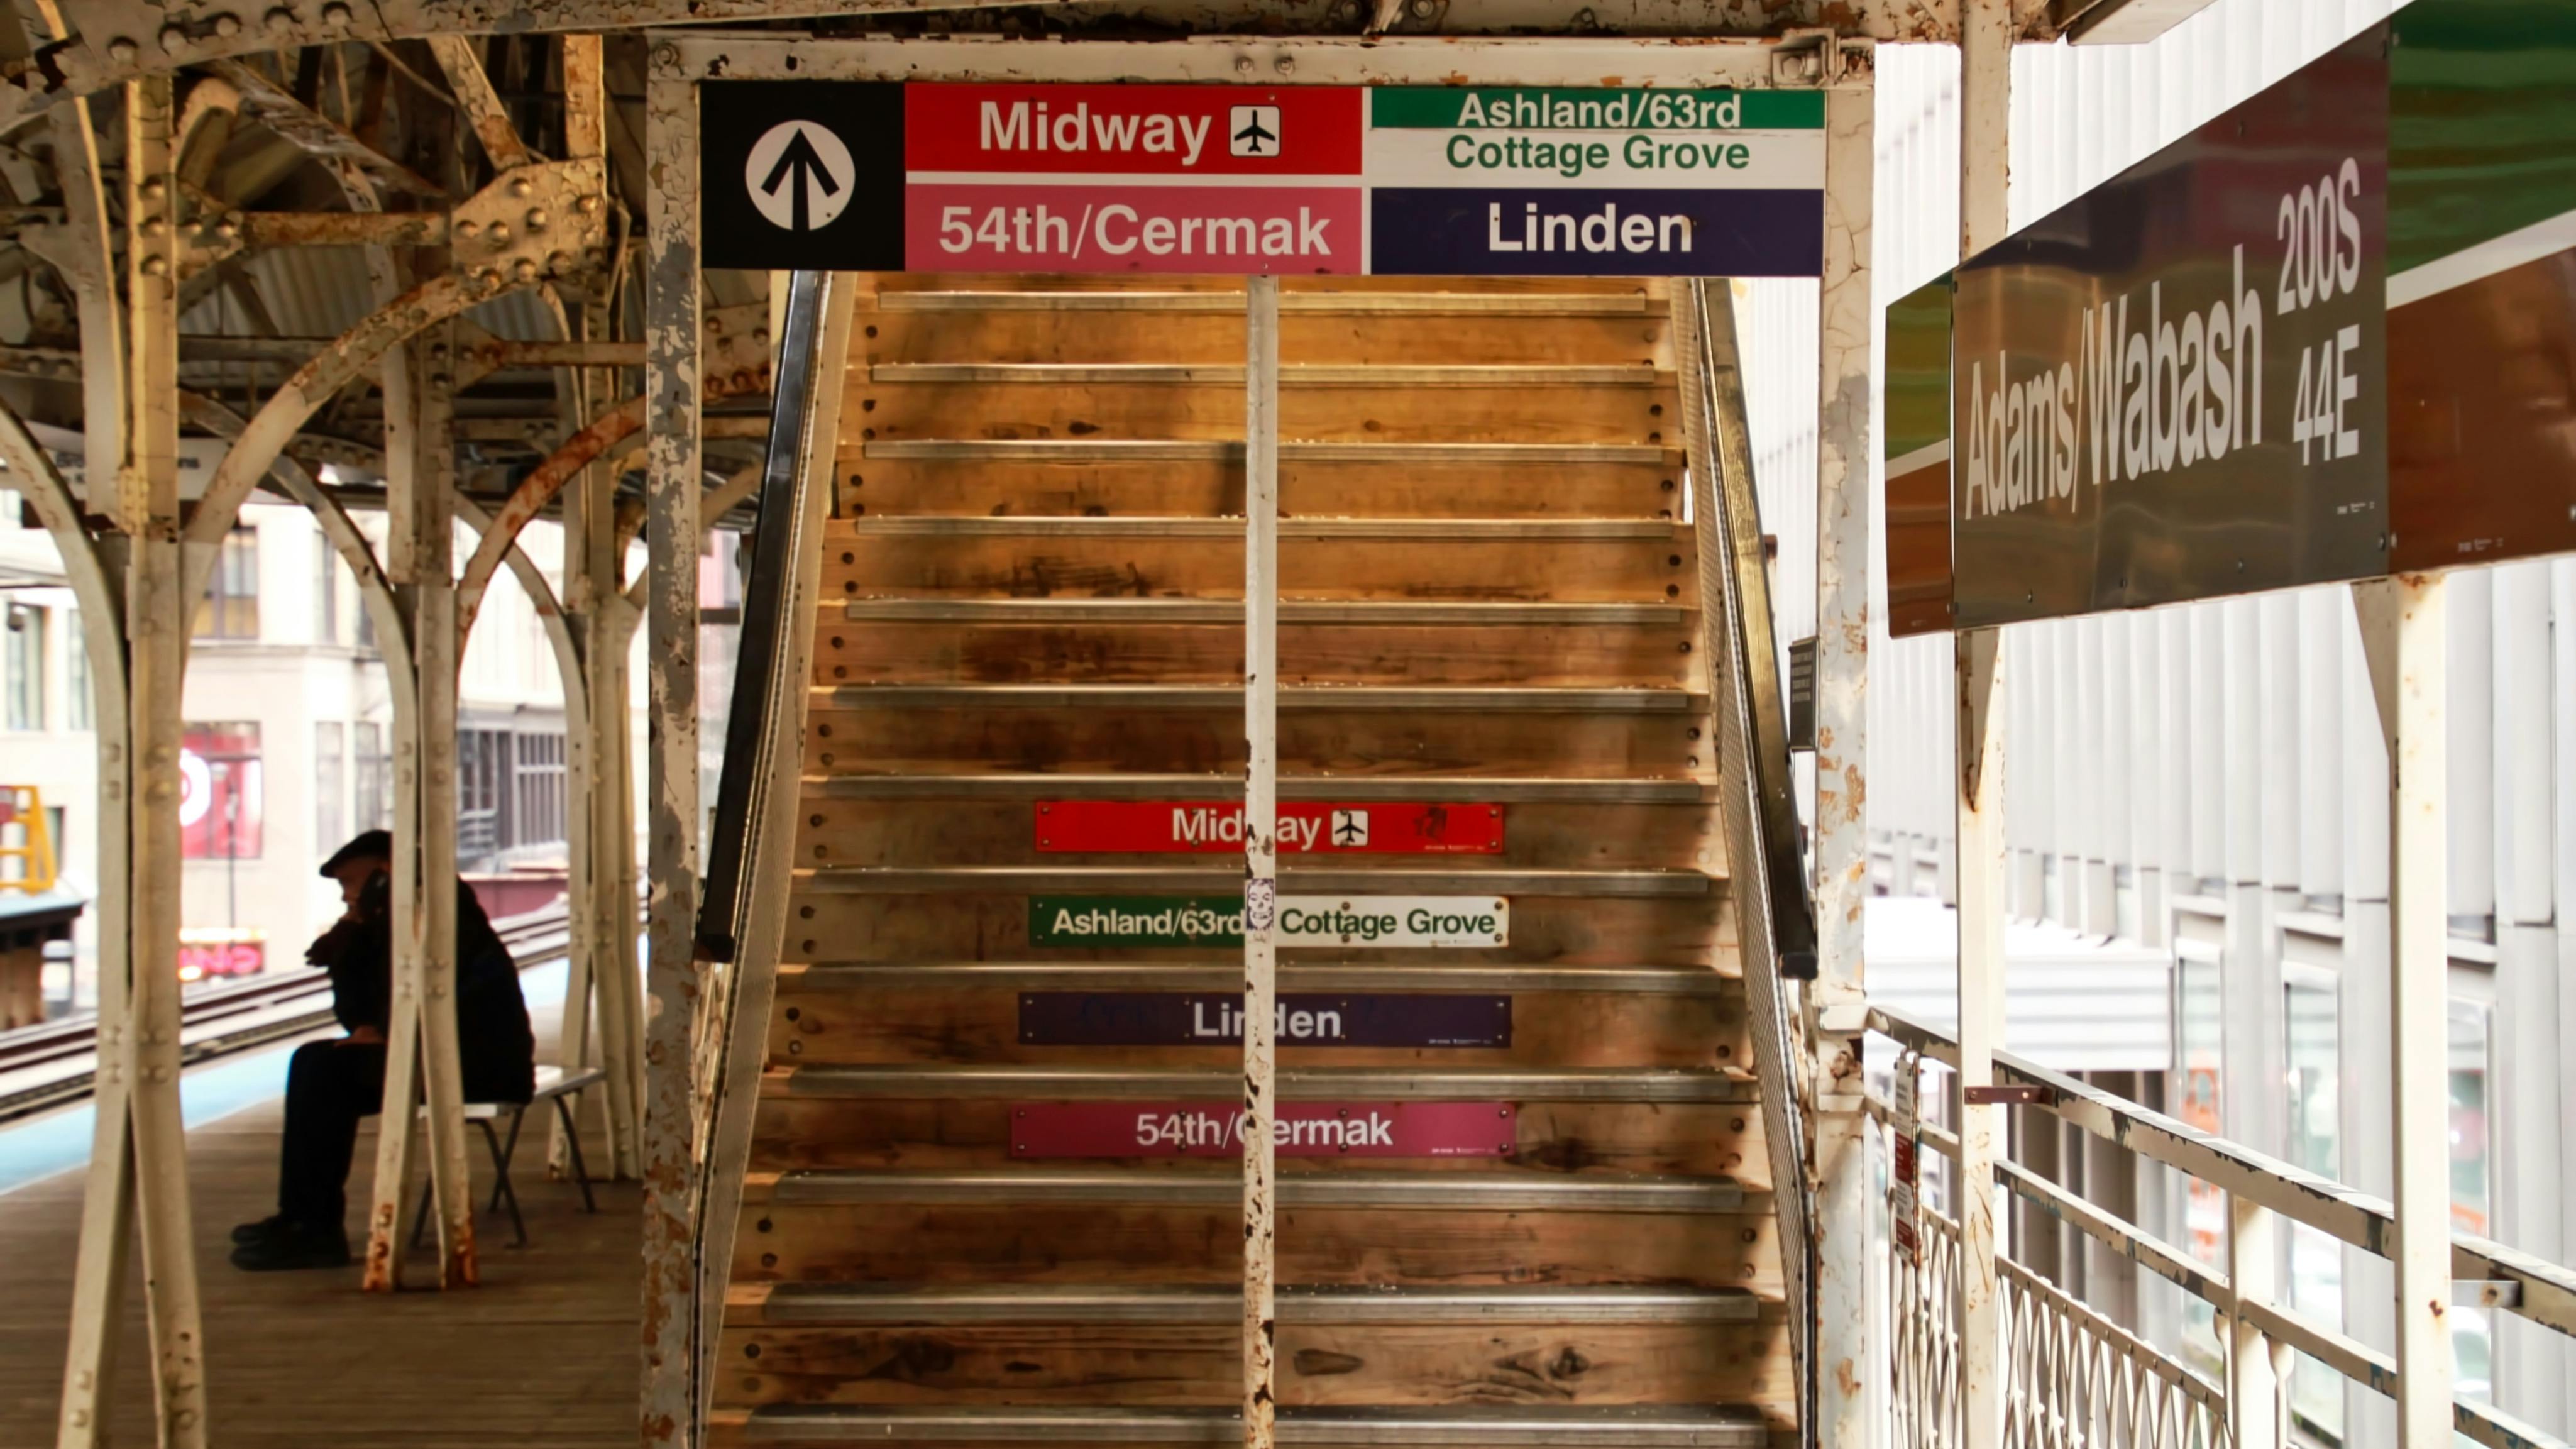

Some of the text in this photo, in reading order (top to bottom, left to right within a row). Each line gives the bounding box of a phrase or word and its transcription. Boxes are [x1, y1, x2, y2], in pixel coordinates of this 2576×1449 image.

[979, 101, 1212, 166] Midway
[1456, 92, 1741, 129] Ashland/63rd
[1446, 134, 1751, 177] Cottage Grove
[938, 202, 1332, 259] 54th/Cermak
[1489, 202, 1693, 253] Linden
[2277, 156, 2361, 316] 200S
[1964, 243, 2262, 520] Adams/Wabash
[2292, 324, 2361, 466] 44E
[1172, 808, 1322, 851] Miday
[1052, 907, 1496, 940] Ashland/63rd Cottage Grove
[1135, 1111, 1394, 1149] 54th/ermak
